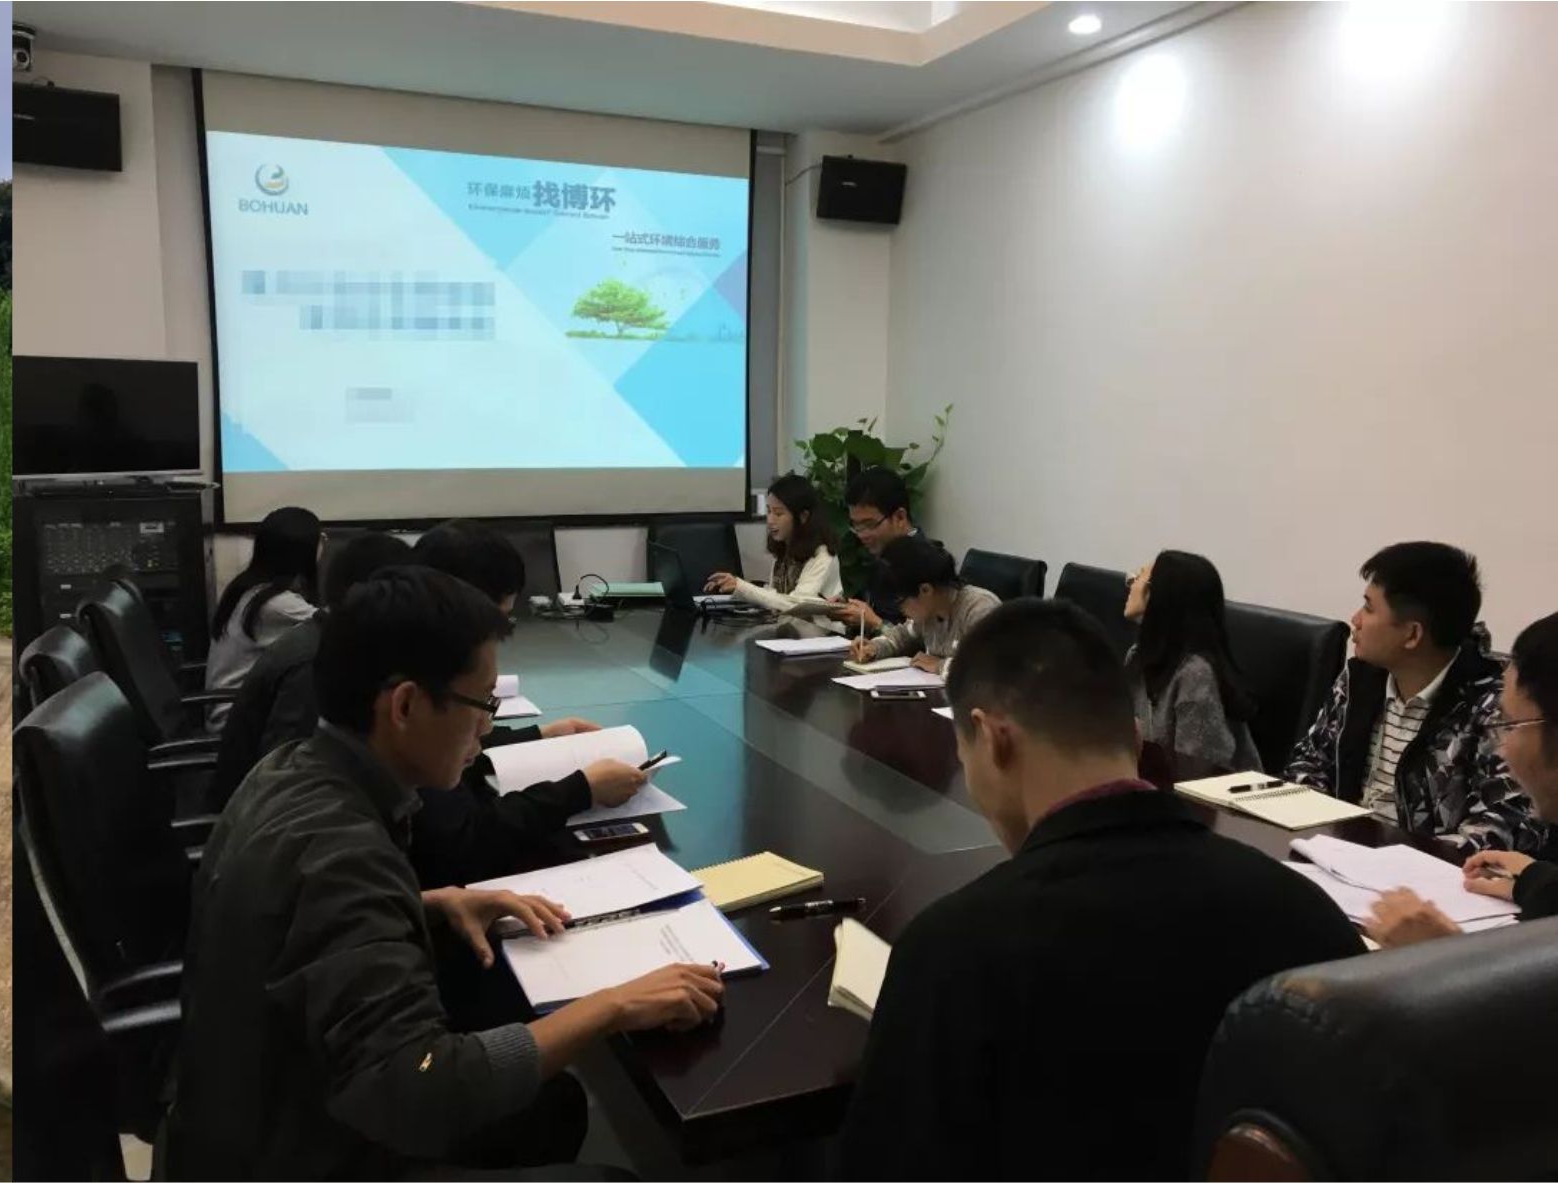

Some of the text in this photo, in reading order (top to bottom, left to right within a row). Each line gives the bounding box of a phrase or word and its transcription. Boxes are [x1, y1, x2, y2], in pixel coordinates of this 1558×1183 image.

[238, 198, 309, 216] BOHUAN
[533, 179, 617, 213] 找博环
